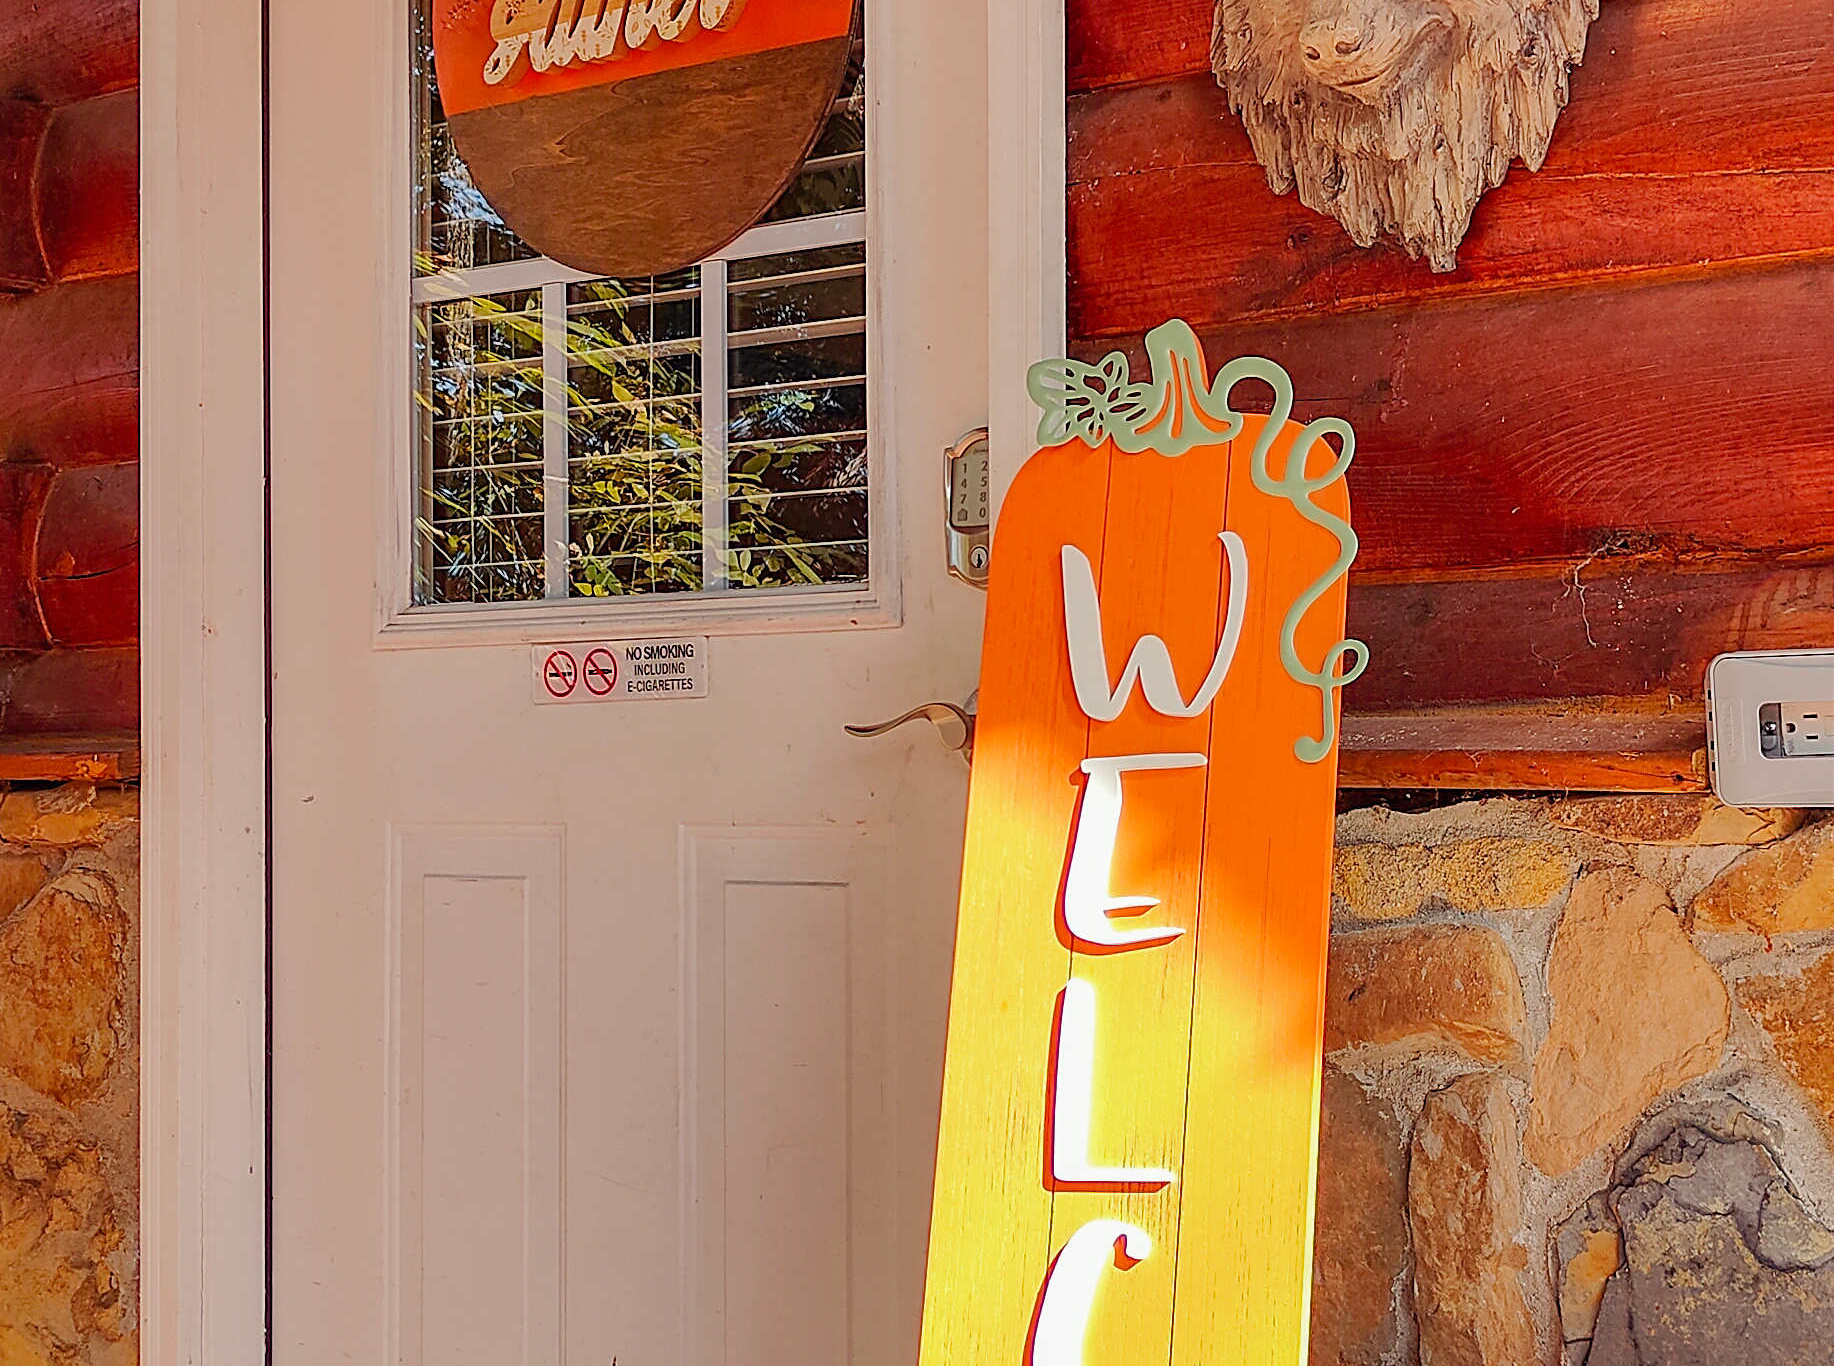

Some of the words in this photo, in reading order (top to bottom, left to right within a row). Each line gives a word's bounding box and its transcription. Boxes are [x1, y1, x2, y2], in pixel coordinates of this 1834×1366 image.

[962, 463, 968, 474] 1
[981, 460, 988, 472] 2
[961, 478, 967, 489] 4
[980, 476, 988, 488] 5
[960, 493, 967, 505] 7
[979, 491, 987, 503] 8
[979, 507, 987, 519] 0
[625, 646, 642, 661] NO
[643, 643, 694, 660] SMOKING
[634, 661, 686, 676] INCLUDING
[627, 677, 694, 693] E-CIGARETTES
